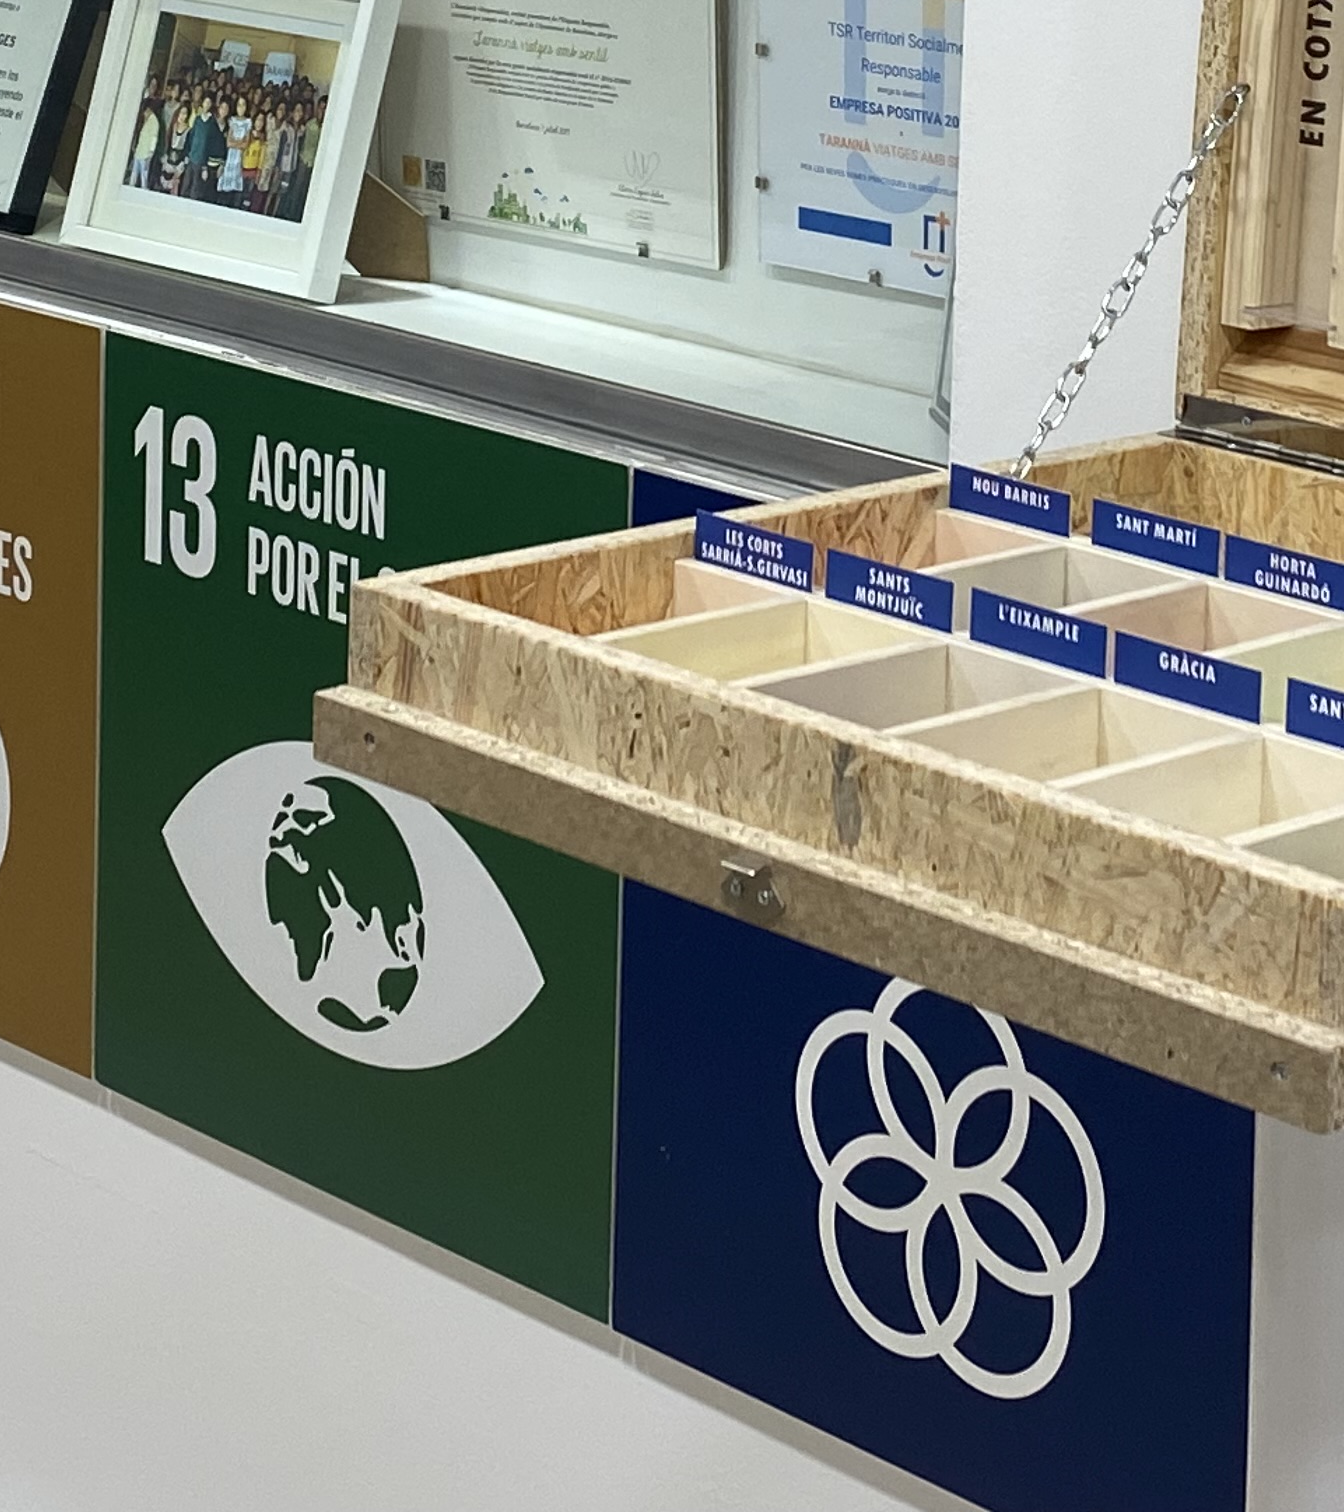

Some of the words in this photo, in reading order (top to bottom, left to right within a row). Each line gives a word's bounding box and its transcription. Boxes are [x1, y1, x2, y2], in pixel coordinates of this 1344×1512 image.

[827, 20, 854, 39] TSR
[856, 25, 905, 48] Territori
[860, 56, 942, 85] Responsable
[829, 94, 886, 117] EMPRESA
[886, 103, 943, 127] POSITIVA
[1299, 98, 1327, 149] EN
[133, 404, 217, 580] 13
[247, 433, 387, 541] ACCIÓN
[971, 475, 1000, 499] NOU
[1003, 483, 1051, 512] BARRIS
[725, 528, 745, 548] LES
[747, 534, 784, 560] CORTS
[1114, 512, 1151, 538] SANT
[1153, 520, 1198, 548] MARTÍ
[247, 525, 320, 617] POR
[867, 566, 911, 596] SANTS
[1269, 552, 1317, 581] HORTA
[855, 584, 924, 622] MONTJUÏC
[1254, 568, 1332, 605] GUINARDÓ
[998, 602, 1080, 645] L'EIXAMPLE
[1159, 649, 1217, 686] GRÀCIA
